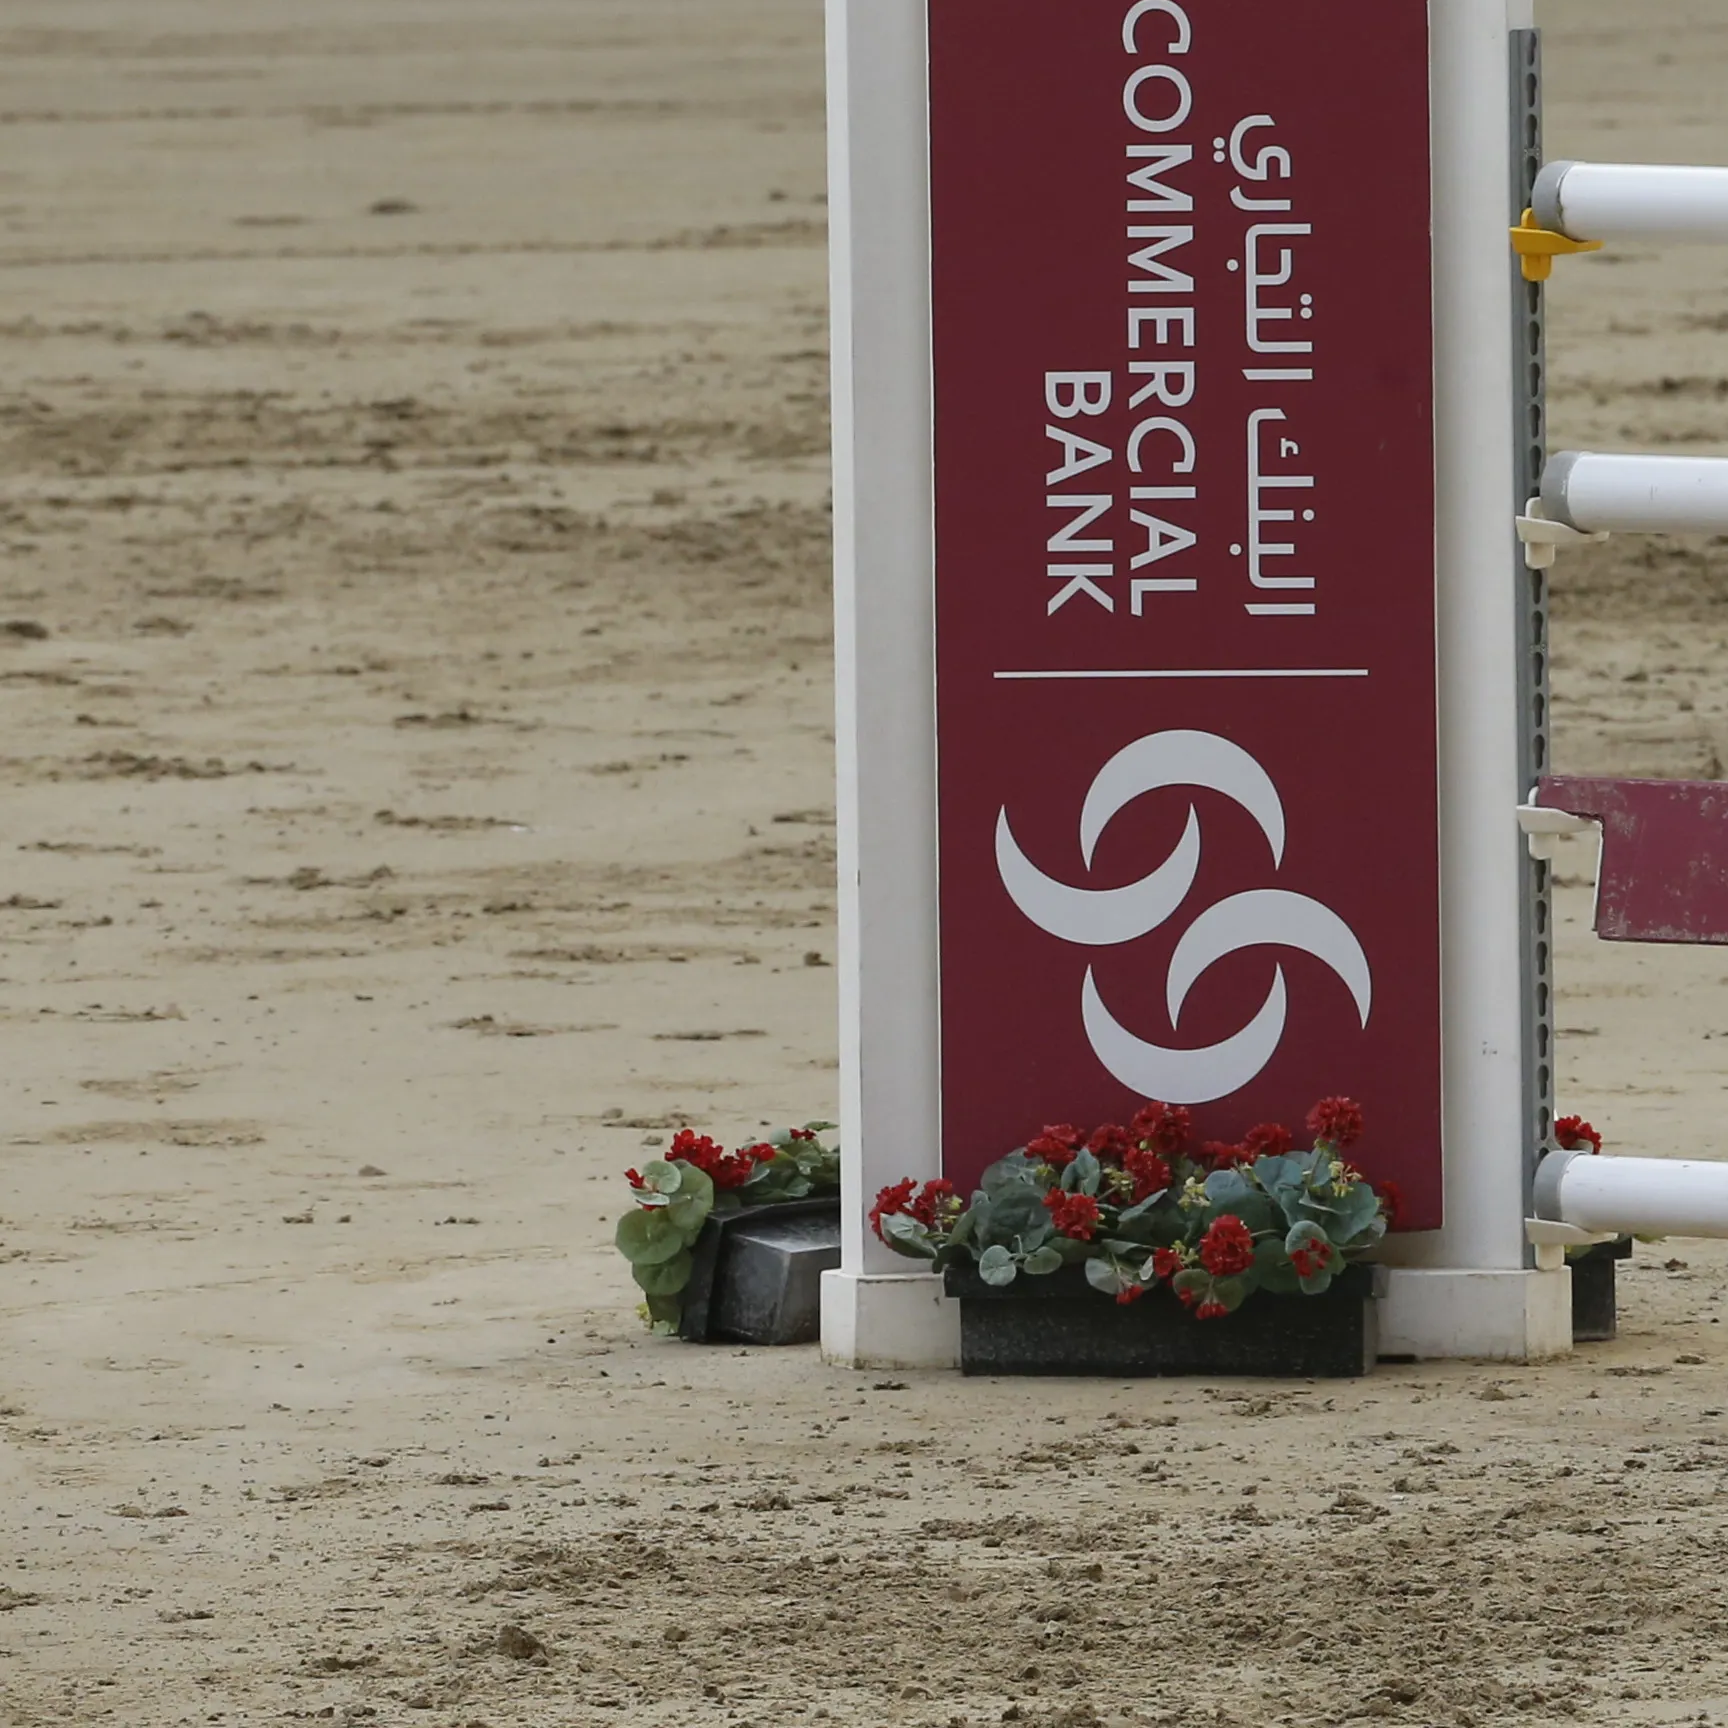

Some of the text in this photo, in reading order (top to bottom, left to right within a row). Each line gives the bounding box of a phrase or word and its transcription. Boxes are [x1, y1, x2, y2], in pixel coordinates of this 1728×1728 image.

[1044, 370, 1114, 617] BANK
[1213, 114, 1316, 615] البنك التجاري
